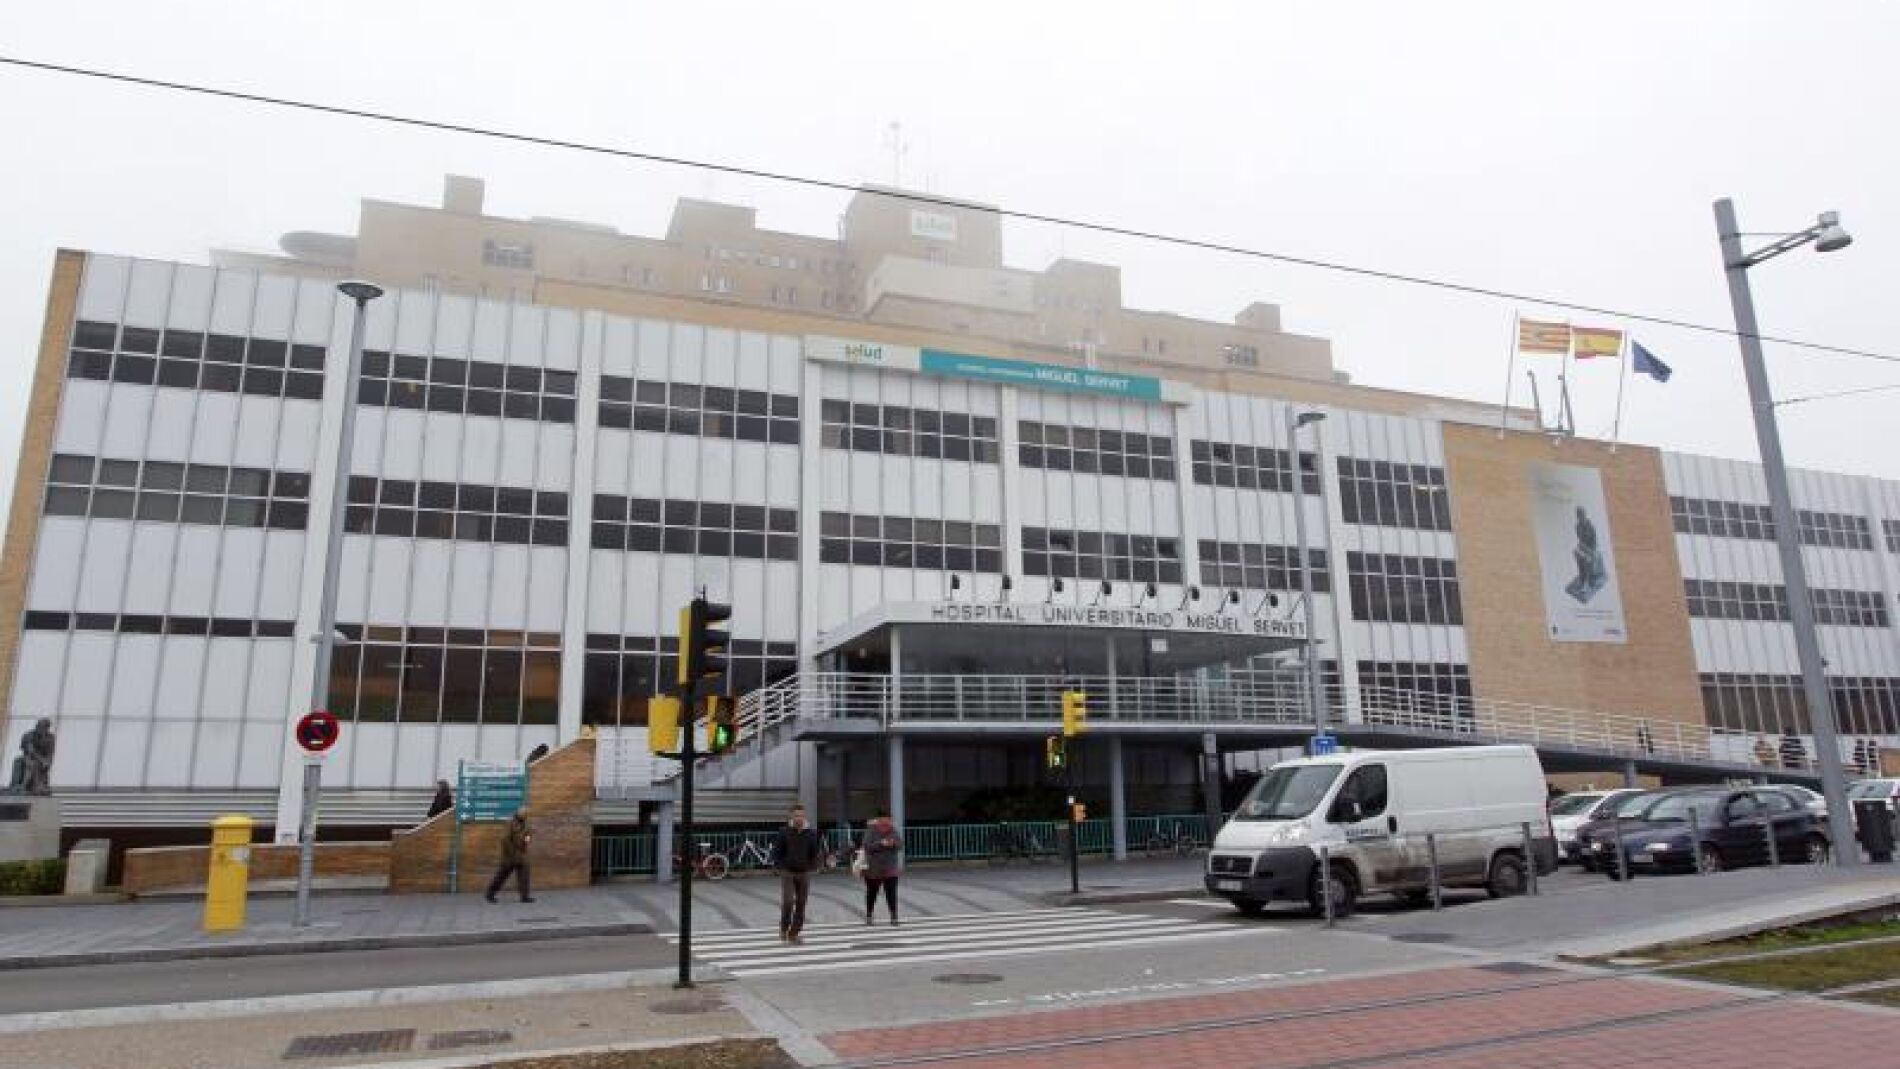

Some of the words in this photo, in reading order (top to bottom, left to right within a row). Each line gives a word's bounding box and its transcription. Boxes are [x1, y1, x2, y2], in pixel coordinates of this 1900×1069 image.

[931, 604, 1026, 622] HOSPITAL
[1042, 605, 1174, 628] UNIVERSITARIO
[1186, 613, 1243, 633] MIGUEL
